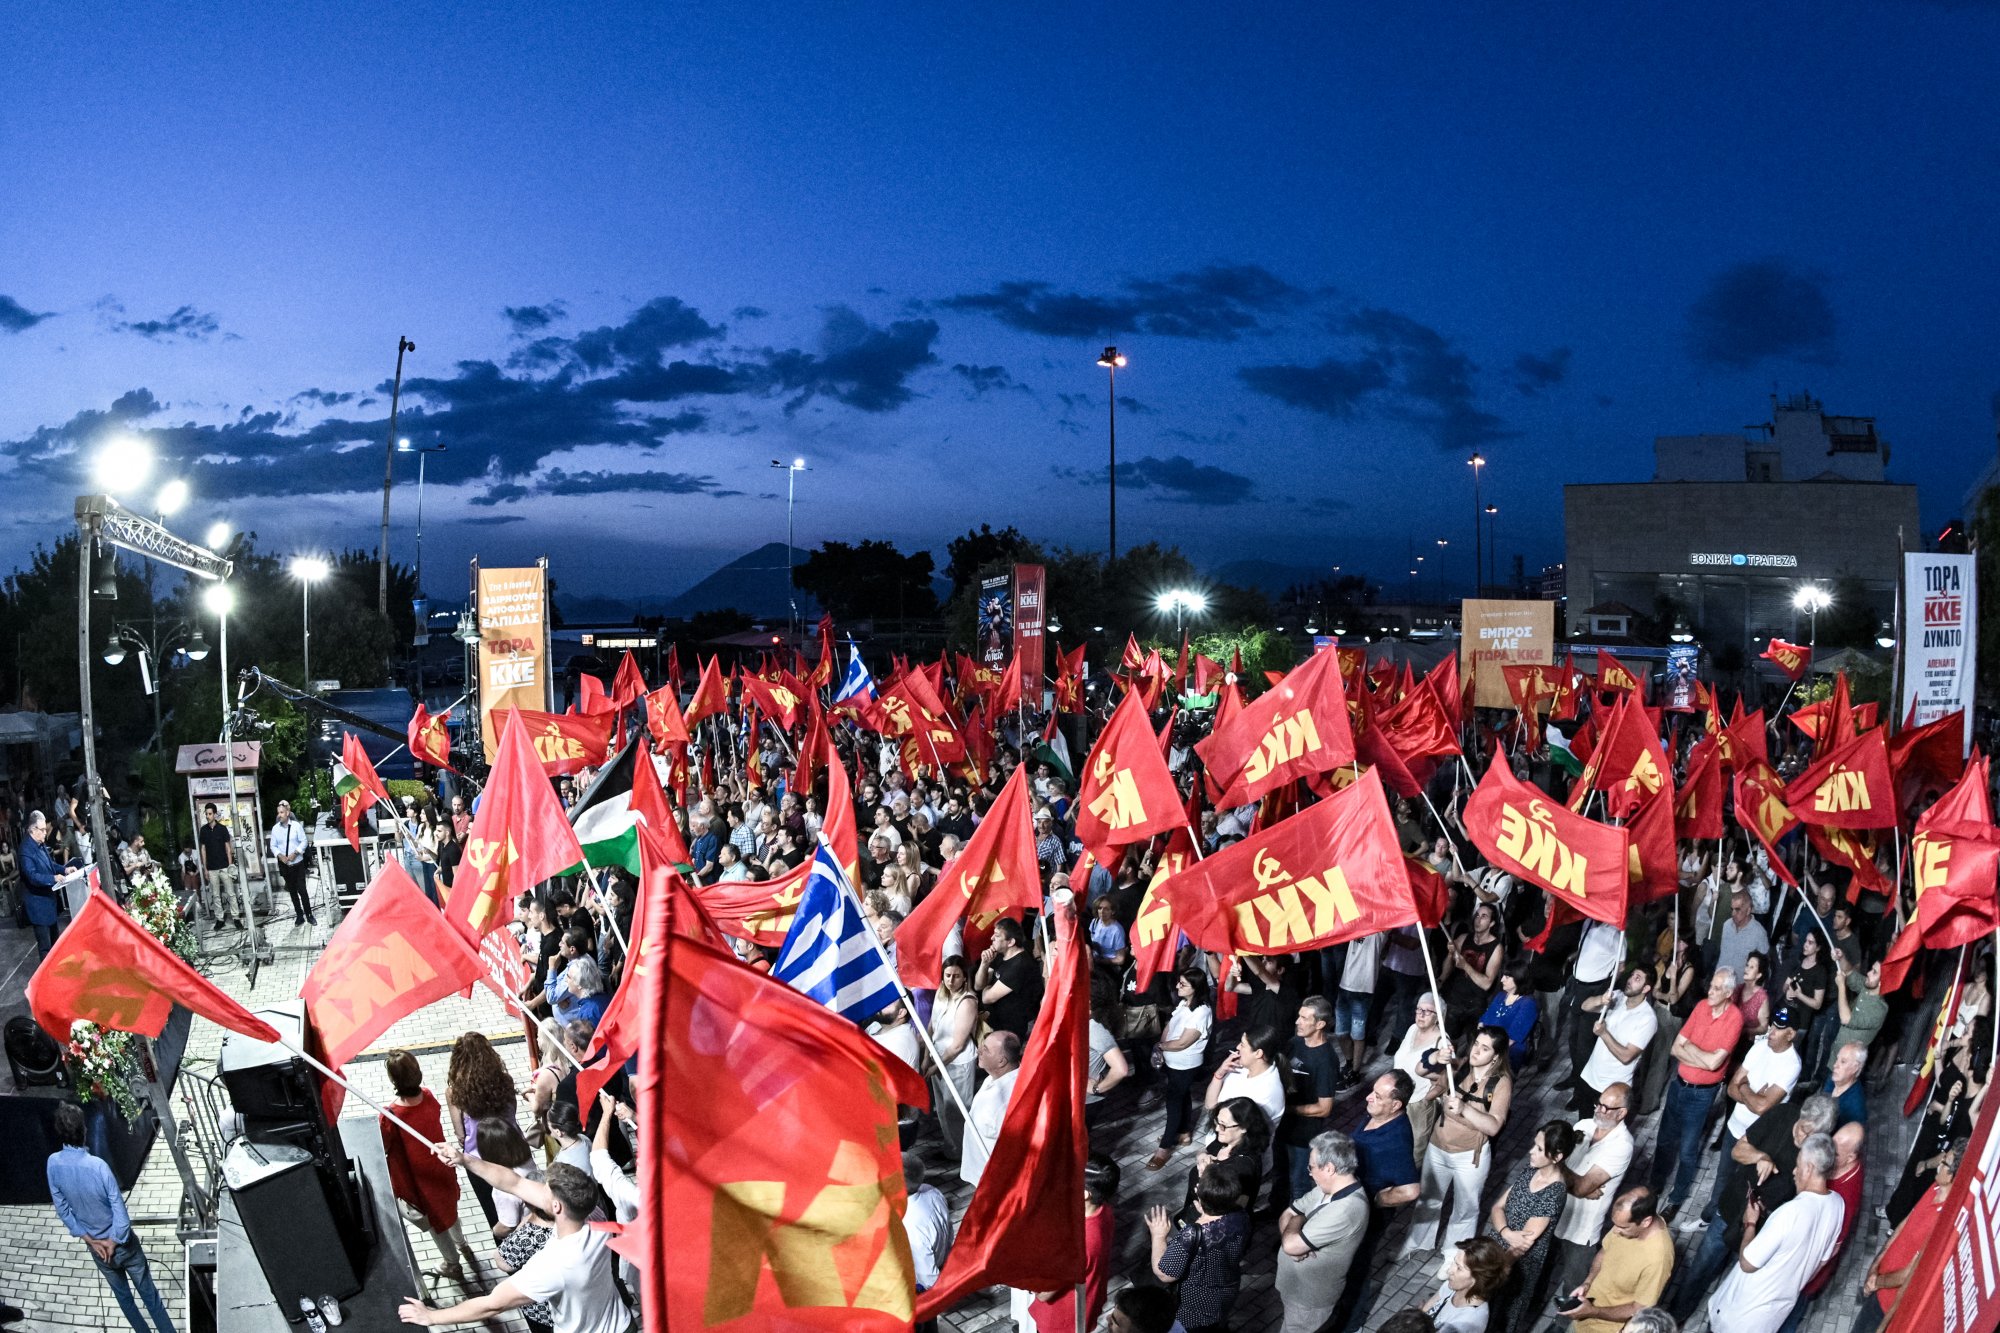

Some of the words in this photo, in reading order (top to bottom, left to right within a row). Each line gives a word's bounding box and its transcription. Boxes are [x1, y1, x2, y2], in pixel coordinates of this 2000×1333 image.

[1690, 553, 1731, 565] ΕΘΝΙΚΗ
[1747, 554, 1797, 567] ΤΡΑΠΕΖΑ
[1924, 565, 1960, 591] ΤΩΡΑ
[1020, 596, 1038, 605] ΚΚΕ
[487, 603, 534, 615] ΑΠΟΦΑΣΗ
[1925, 601, 1961, 622] ΚΚΕ
[482, 613, 539, 629] ΕΛΠΙΔΑΣ
[1480, 626, 1533, 639] ΕΜΠΡΟΣ
[1924, 629, 1961, 648] ΔΥΝΑΤΟ
[488, 637, 535, 654] ΤΩΡΑ
[1491, 638, 1519, 650] ΛΑΕ
[490, 662, 534, 686] ΚΚΕ
